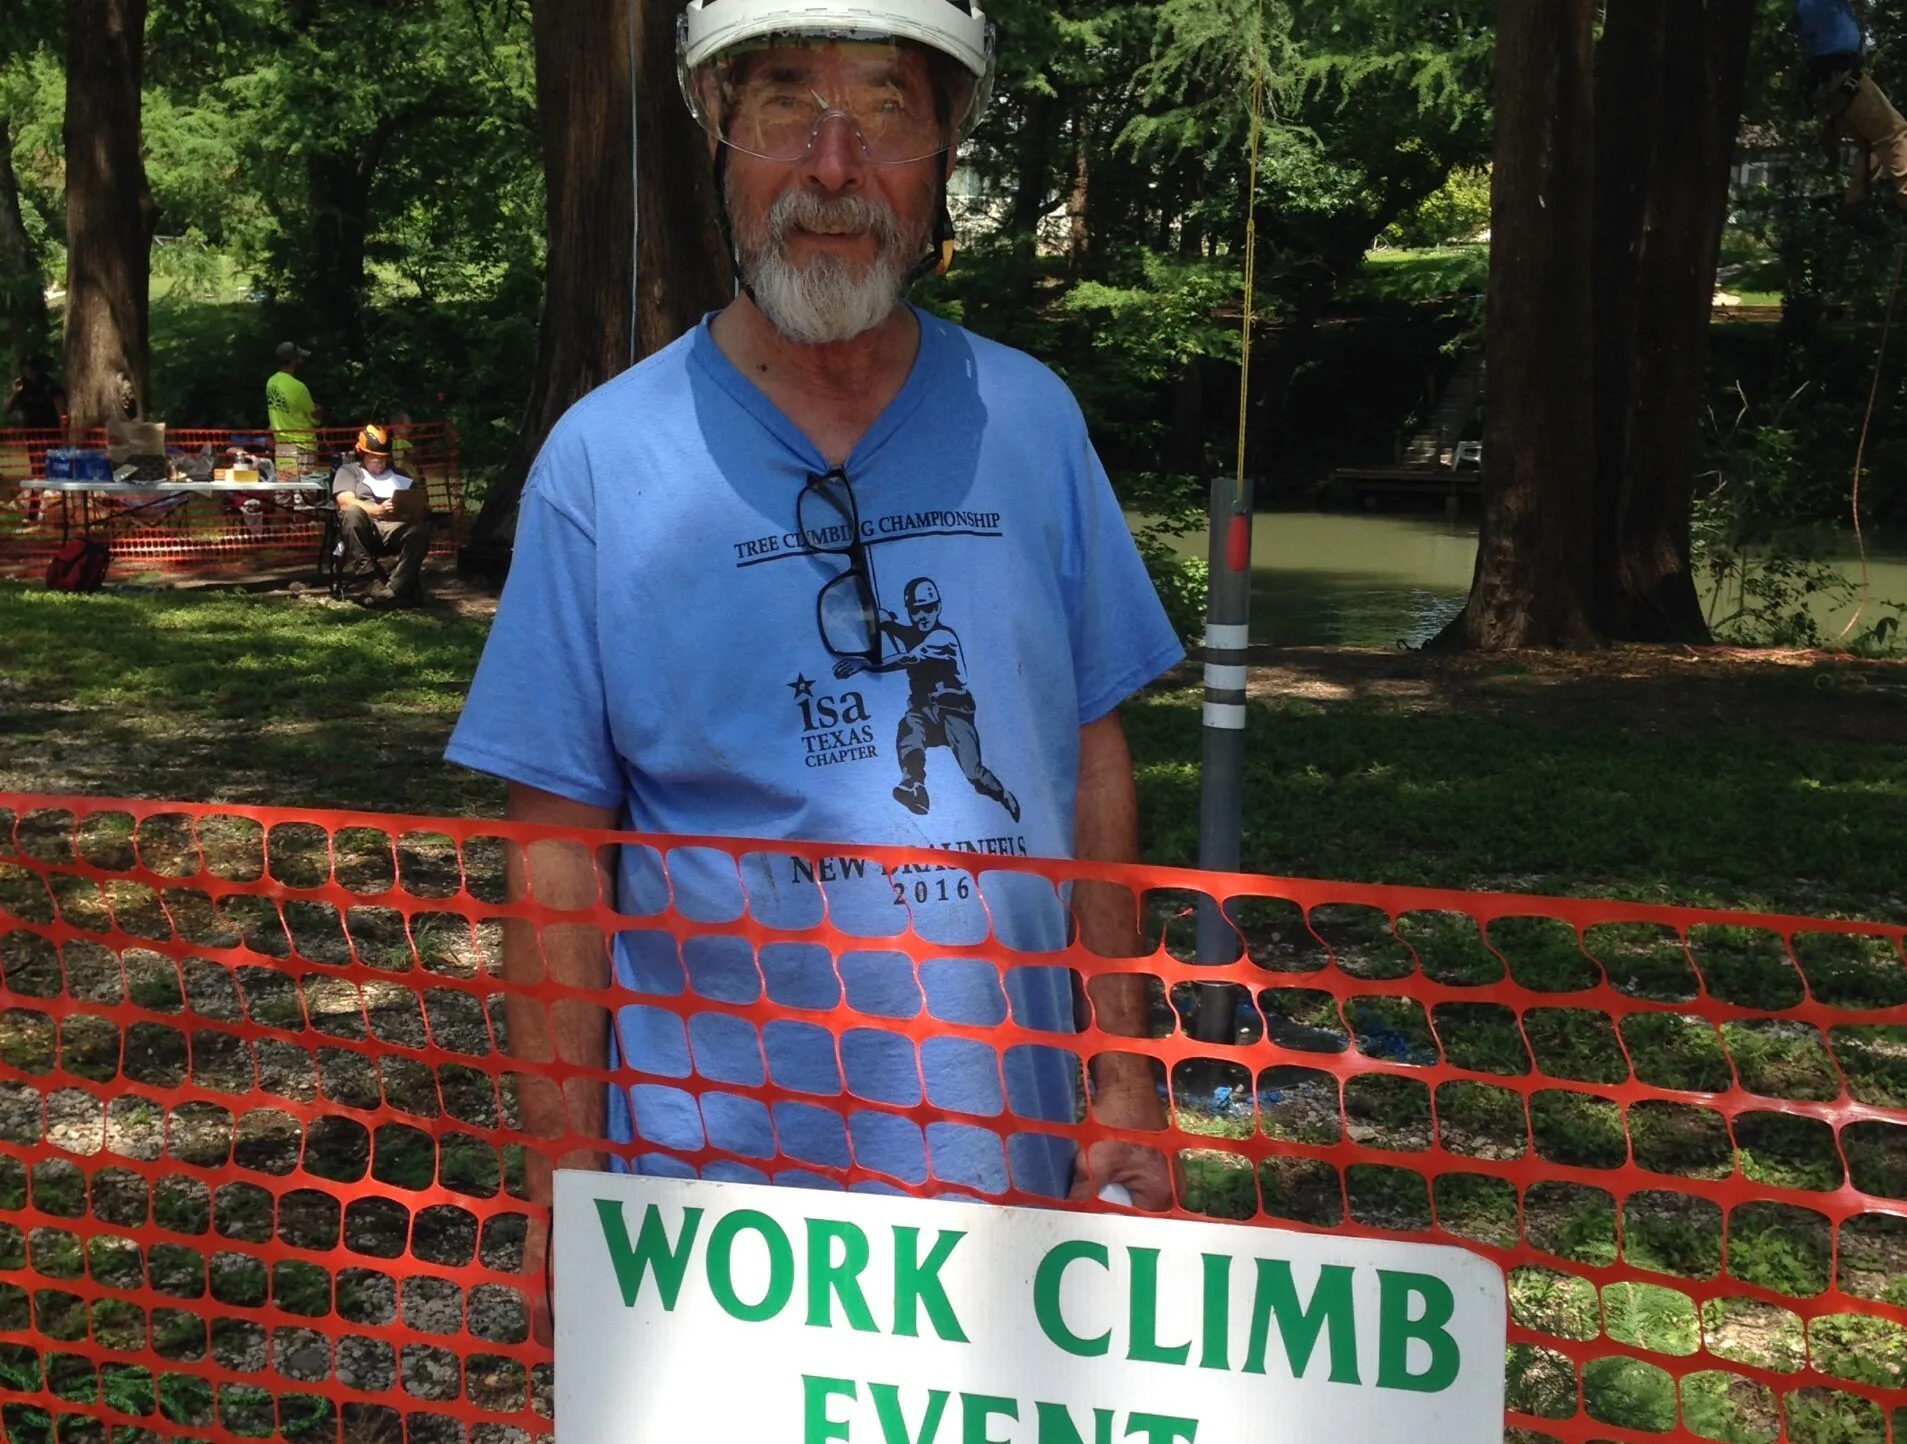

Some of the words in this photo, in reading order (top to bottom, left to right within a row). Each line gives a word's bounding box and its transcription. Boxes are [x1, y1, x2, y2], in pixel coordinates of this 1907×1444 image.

[734, 535, 779, 559] TREE
[783, 520, 874, 548] CLMBIG
[879, 511, 1000, 534] CHAMPIONSHIP
[797, 691, 872, 732] isa
[801, 725, 874, 753] TEXAS
[805, 745, 878, 768] CHAPTER
[790, 855, 865, 883] NEW
[893, 876, 969, 905] 2016
[593, 1198, 971, 1344] WORK
[1033, 1239, 1461, 1394] CLIMB
[800, 1374, 1200, 1444] EVE
